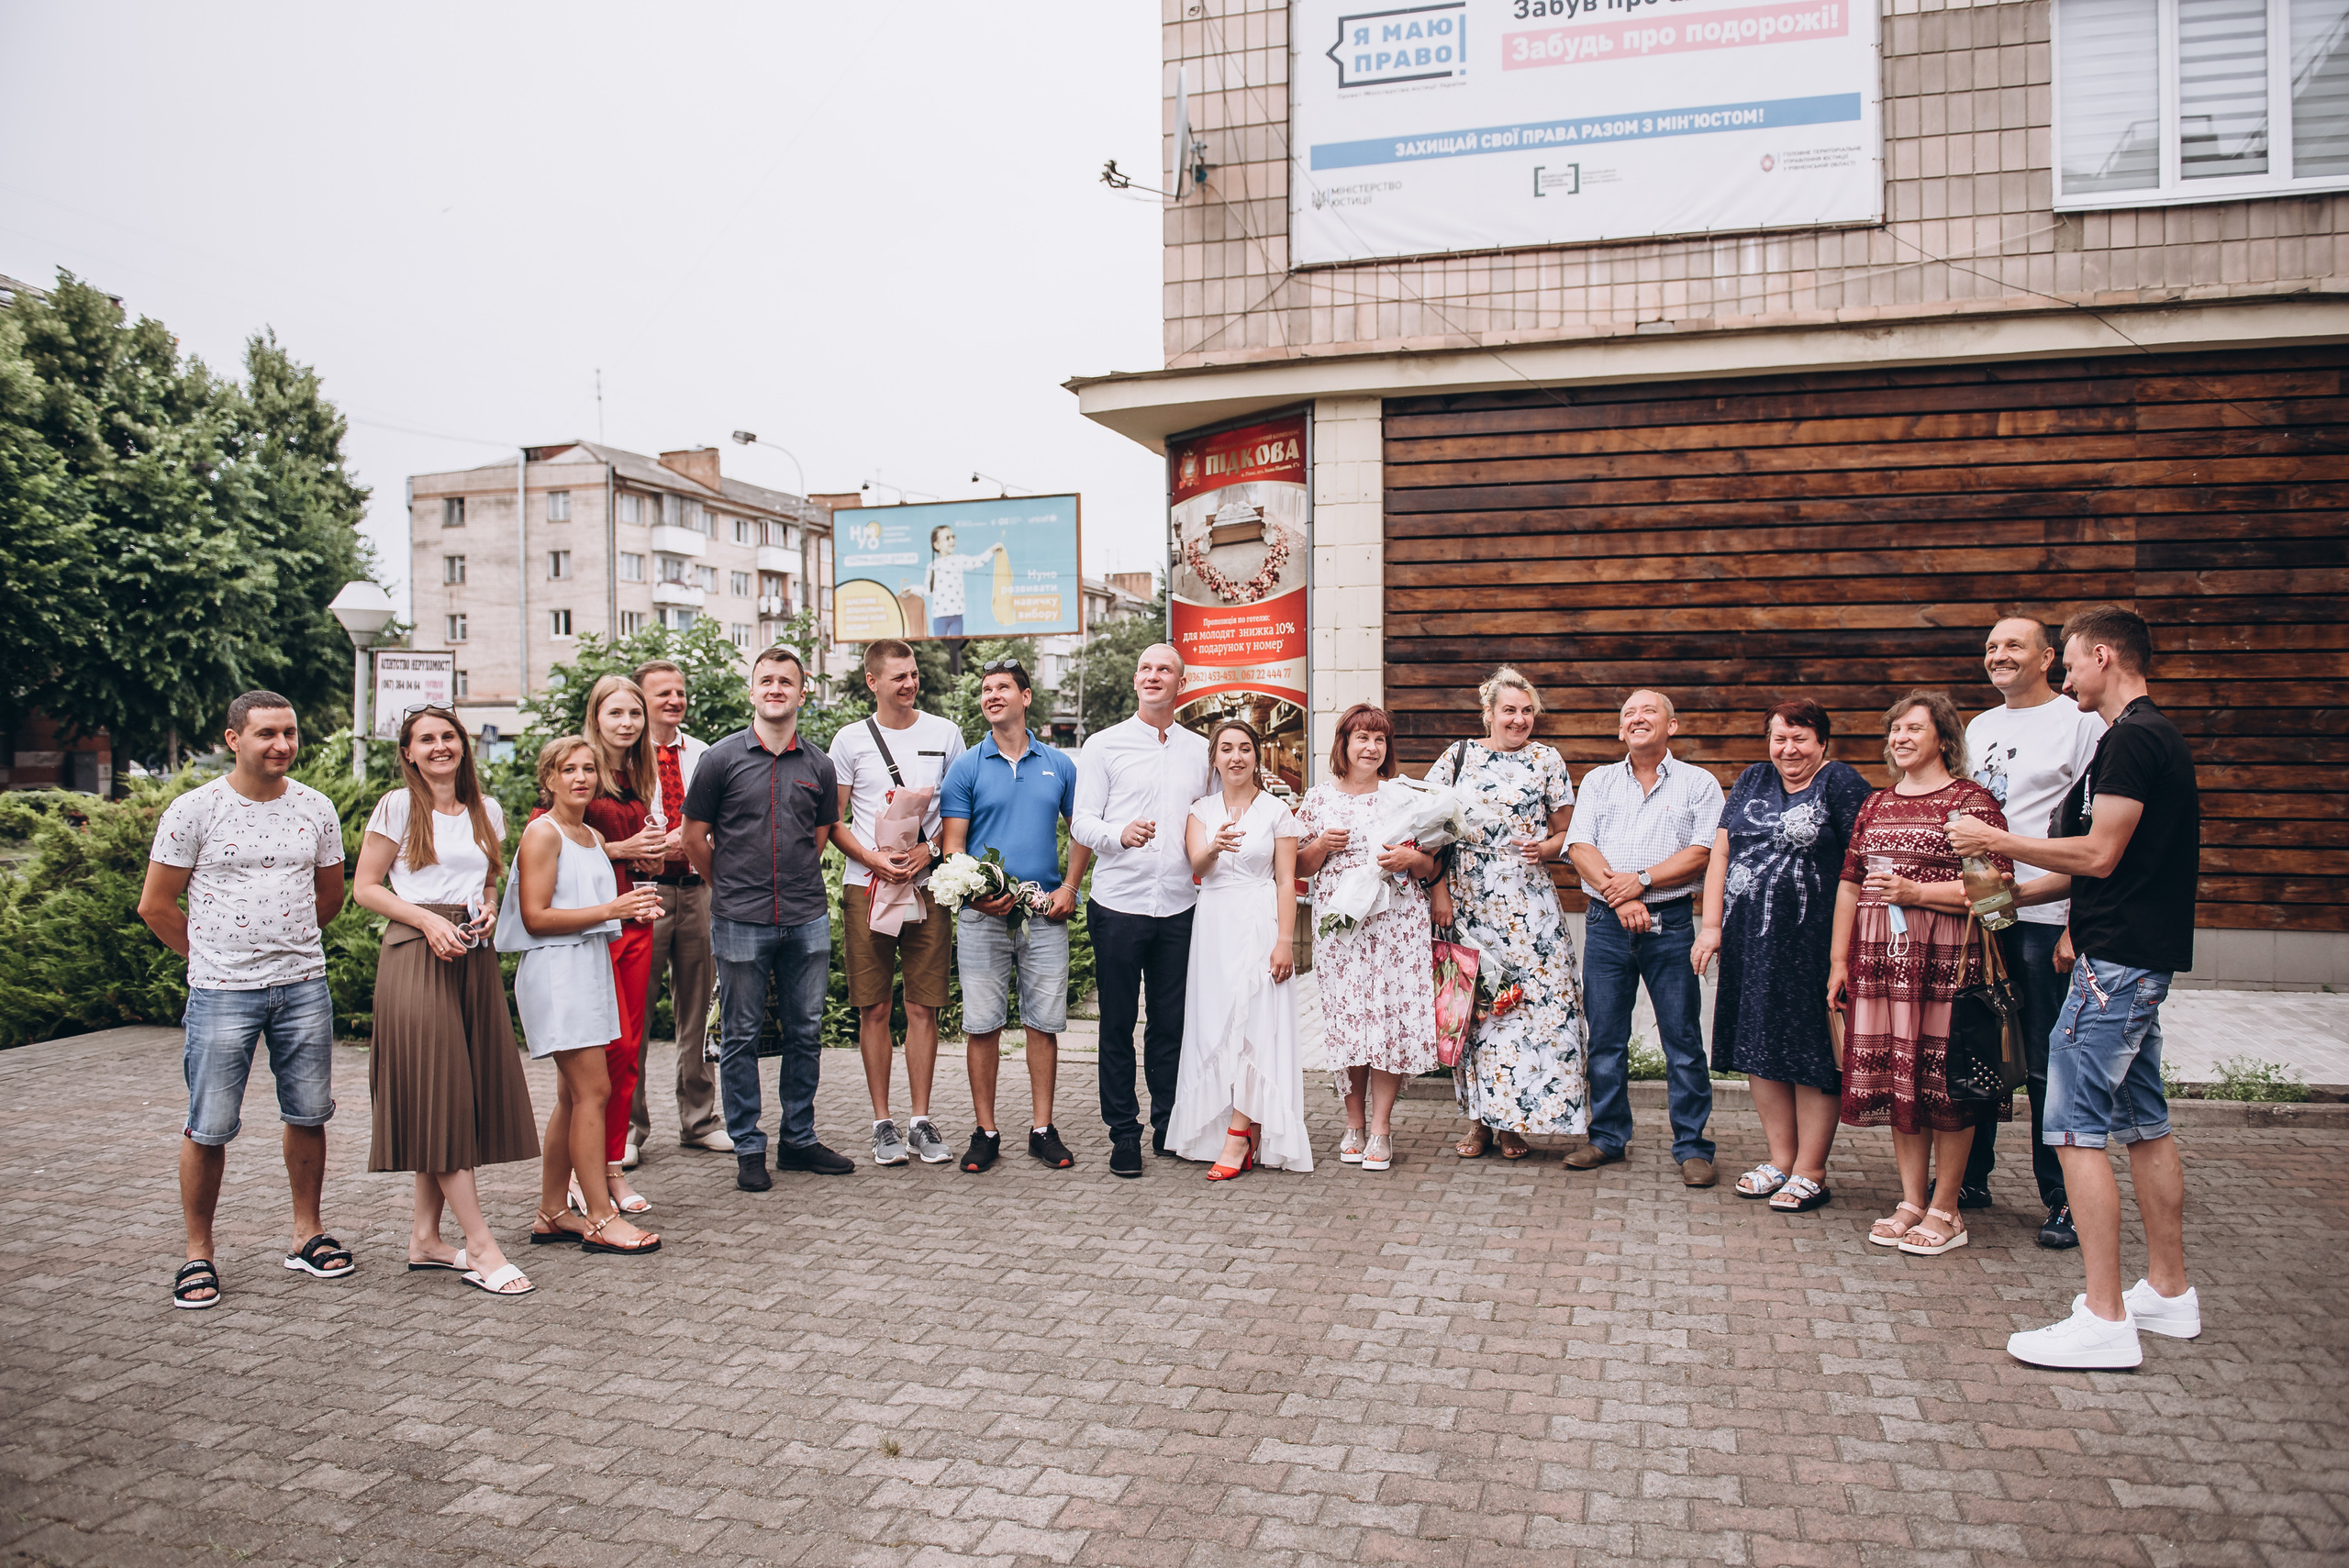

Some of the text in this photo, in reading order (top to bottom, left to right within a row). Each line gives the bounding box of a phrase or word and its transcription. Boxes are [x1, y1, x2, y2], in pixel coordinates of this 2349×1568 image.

[1353, 27, 1369, 46] Я
[1383, 17, 1453, 42] МАЮ
[1512, 6, 1840, 62] Забудь про подорожі!
[1395, 132, 1477, 158] ЗАХИЩАЙ
[1481, 127, 1520, 149] СВОЇ
[1523, 124, 1577, 145] ПРАВА
[1581, 119, 1638, 139] РАЗОМ
[1642, 117, 1653, 134] З
[1206, 438, 1299, 477] ПІДКОВА
[1027, 569, 1058, 582] Нумо
[1000, 584, 1058, 595] розвивати
[1013, 596, 1058, 607] навичку
[1018, 608, 1058, 620] вибору
[1203, 616, 1237, 628] Пропозиція
[1246, 615, 1270, 623] готелю:
[1183, 622, 1296, 643] для молодят знижка 10%
[1198, 642, 1245, 656] подарунок
[1246, 643, 1252, 654] у
[381, 658, 451, 672] АГЕНТСТВО НЕРУХОМОСТІ
[1186, 667, 1291, 684] (0362) 453-453, 067 22 444 77
